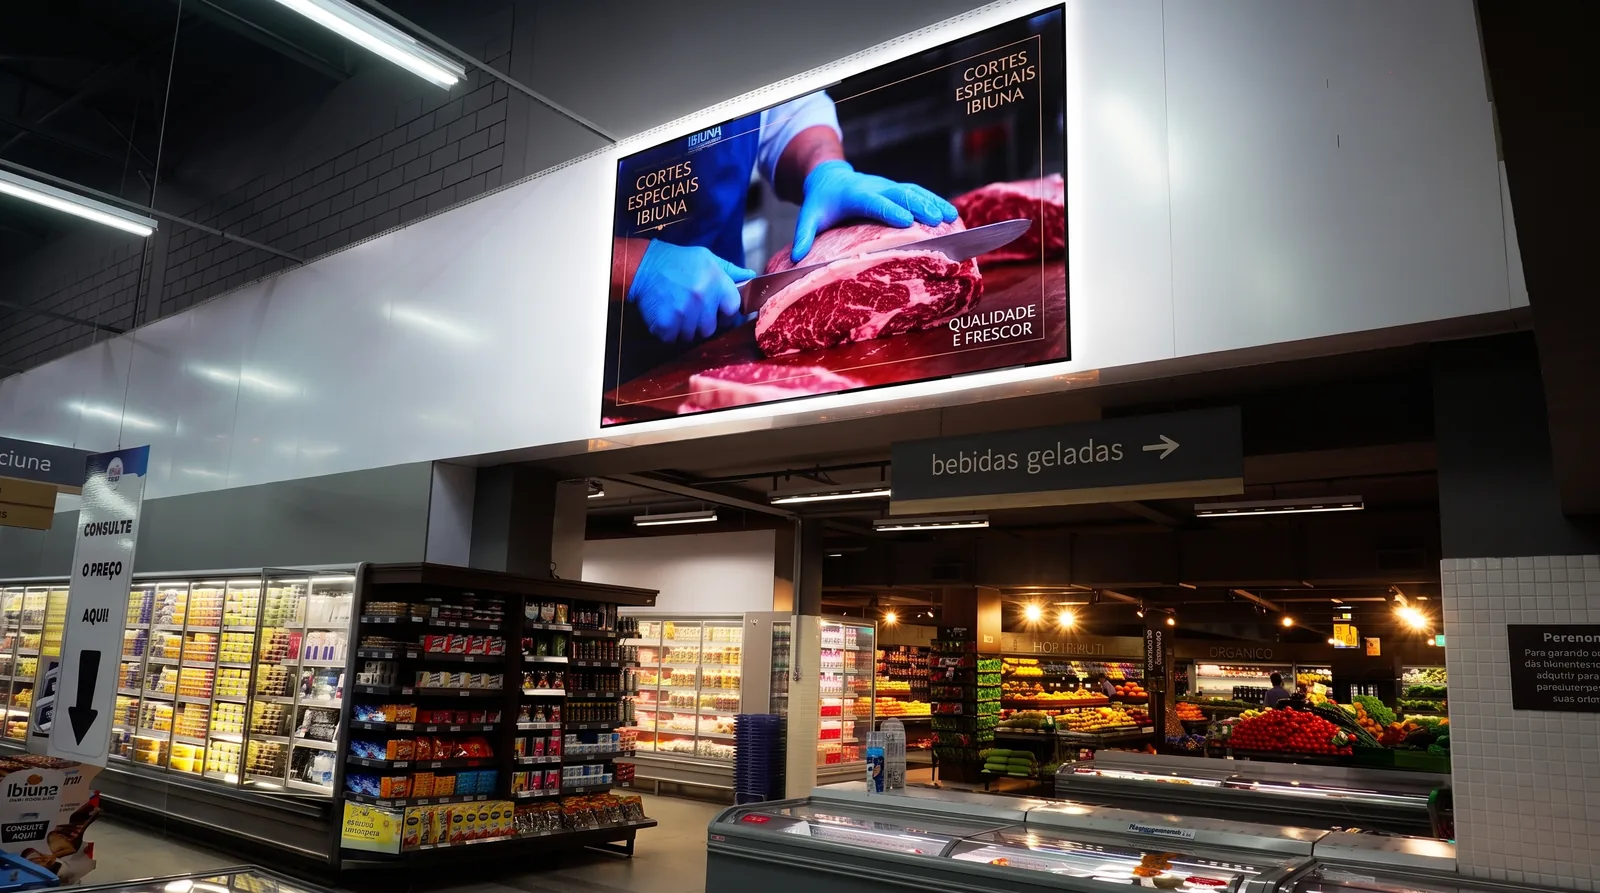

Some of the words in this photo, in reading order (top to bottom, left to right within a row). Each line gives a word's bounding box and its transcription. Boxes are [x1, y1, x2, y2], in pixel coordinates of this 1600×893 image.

[963, 51, 1028, 81] CORTES
[955, 65, 1036, 102] ESPECIAIS
[966, 87, 1025, 115] IBIUNA
[635, 160, 692, 191] CORTES
[627, 176, 700, 211] ESPECIAIS
[636, 198, 688, 226] IBIUNA
[948, 303, 1037, 333] QUALIDADE
[953, 333, 961, 346] E
[965, 321, 1033, 345] FRESCOR
[932, 448, 1019, 476] bebidas
[1027, 438, 1124, 475] geladas
[84, 519, 133, 538] CONSULTE
[82, 562, 90, 578] O
[90, 561, 122, 581] PREÇO
[82, 608, 109, 625] AQUI!
[1524, 648, 1545, 656] Para
[7, 783, 58, 797] Ibiuna
[5, 823, 43, 832] CONSULTE
[12, 831, 36, 840] AQUI!
